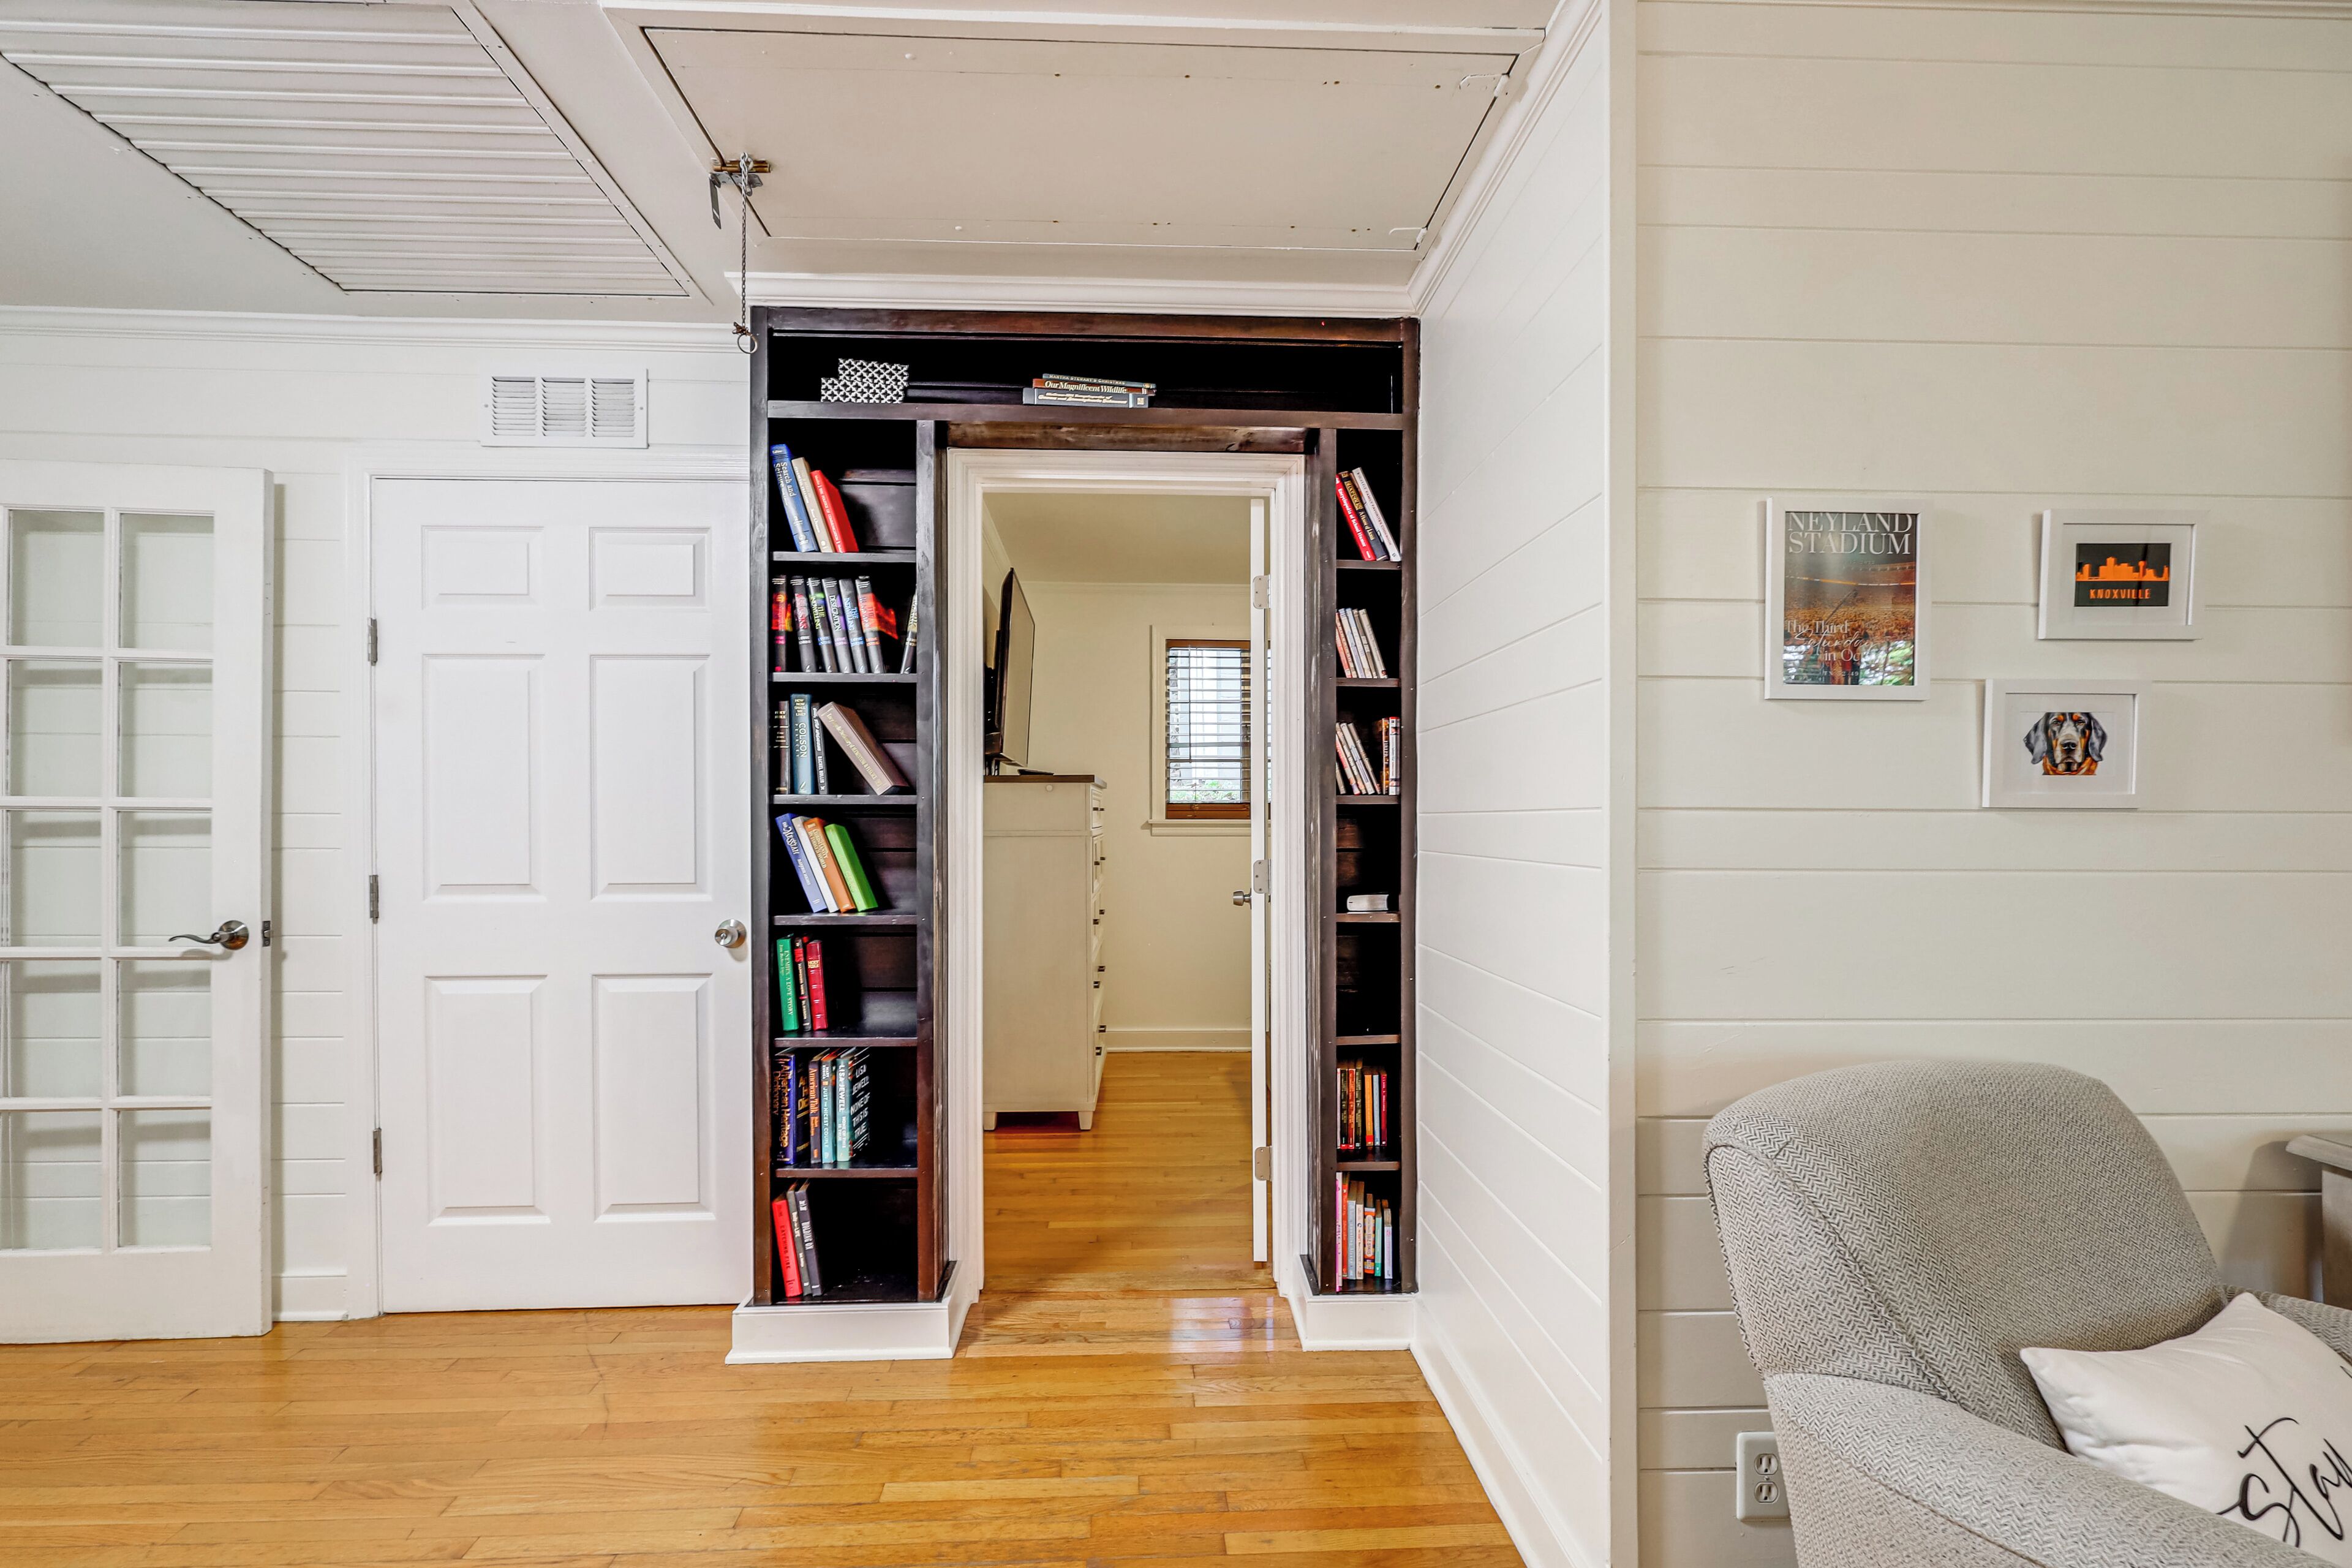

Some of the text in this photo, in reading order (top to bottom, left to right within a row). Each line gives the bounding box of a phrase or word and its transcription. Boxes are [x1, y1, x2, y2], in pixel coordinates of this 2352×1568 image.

[1059, 382, 1101, 392] Magnificent
[1101, 385, 1127, 393] Wildlife
[781, 462, 792, 483] Search
[787, 485, 796, 497] and
[1338, 489, 1352, 514] Encyclopedia
[1351, 519, 1360, 533] School
[1357, 533, 1366, 547] Humor
[1371, 505, 1382, 525] FAVORITES
[1788, 512, 1912, 532] NEYLAND
[1789, 532, 1911, 554] STADIUM
[2090, 589, 2150, 598] KNOXVILLE
[810, 596, 821, 629] INDWELLING
[829, 595, 842, 631] DESECRATION
[843, 597, 854, 631] INDWELLING
[1814, 620, 1849, 633] Third
[1795, 629, 1877, 654] Saturday
[1825, 650, 1836, 661] in
[799, 723, 807, 758] COLSON
[783, 826, 799, 854] MESSIAH
[816, 853, 826, 869] WORLD
[856, 1065, 867, 1078] LISA
[772, 1071, 781, 1115] Dictionary
[809, 1068, 818, 1099] American
[852, 1076, 869, 1095] JEWELL
[779, 1065, 791, 1147] American Heritage
[851, 1093, 870, 1115] NONE OF
[853, 1107, 869, 1127] THIS IS
[854, 1122, 867, 1139] TRUE
[801, 1221, 813, 1242] HOLDING
